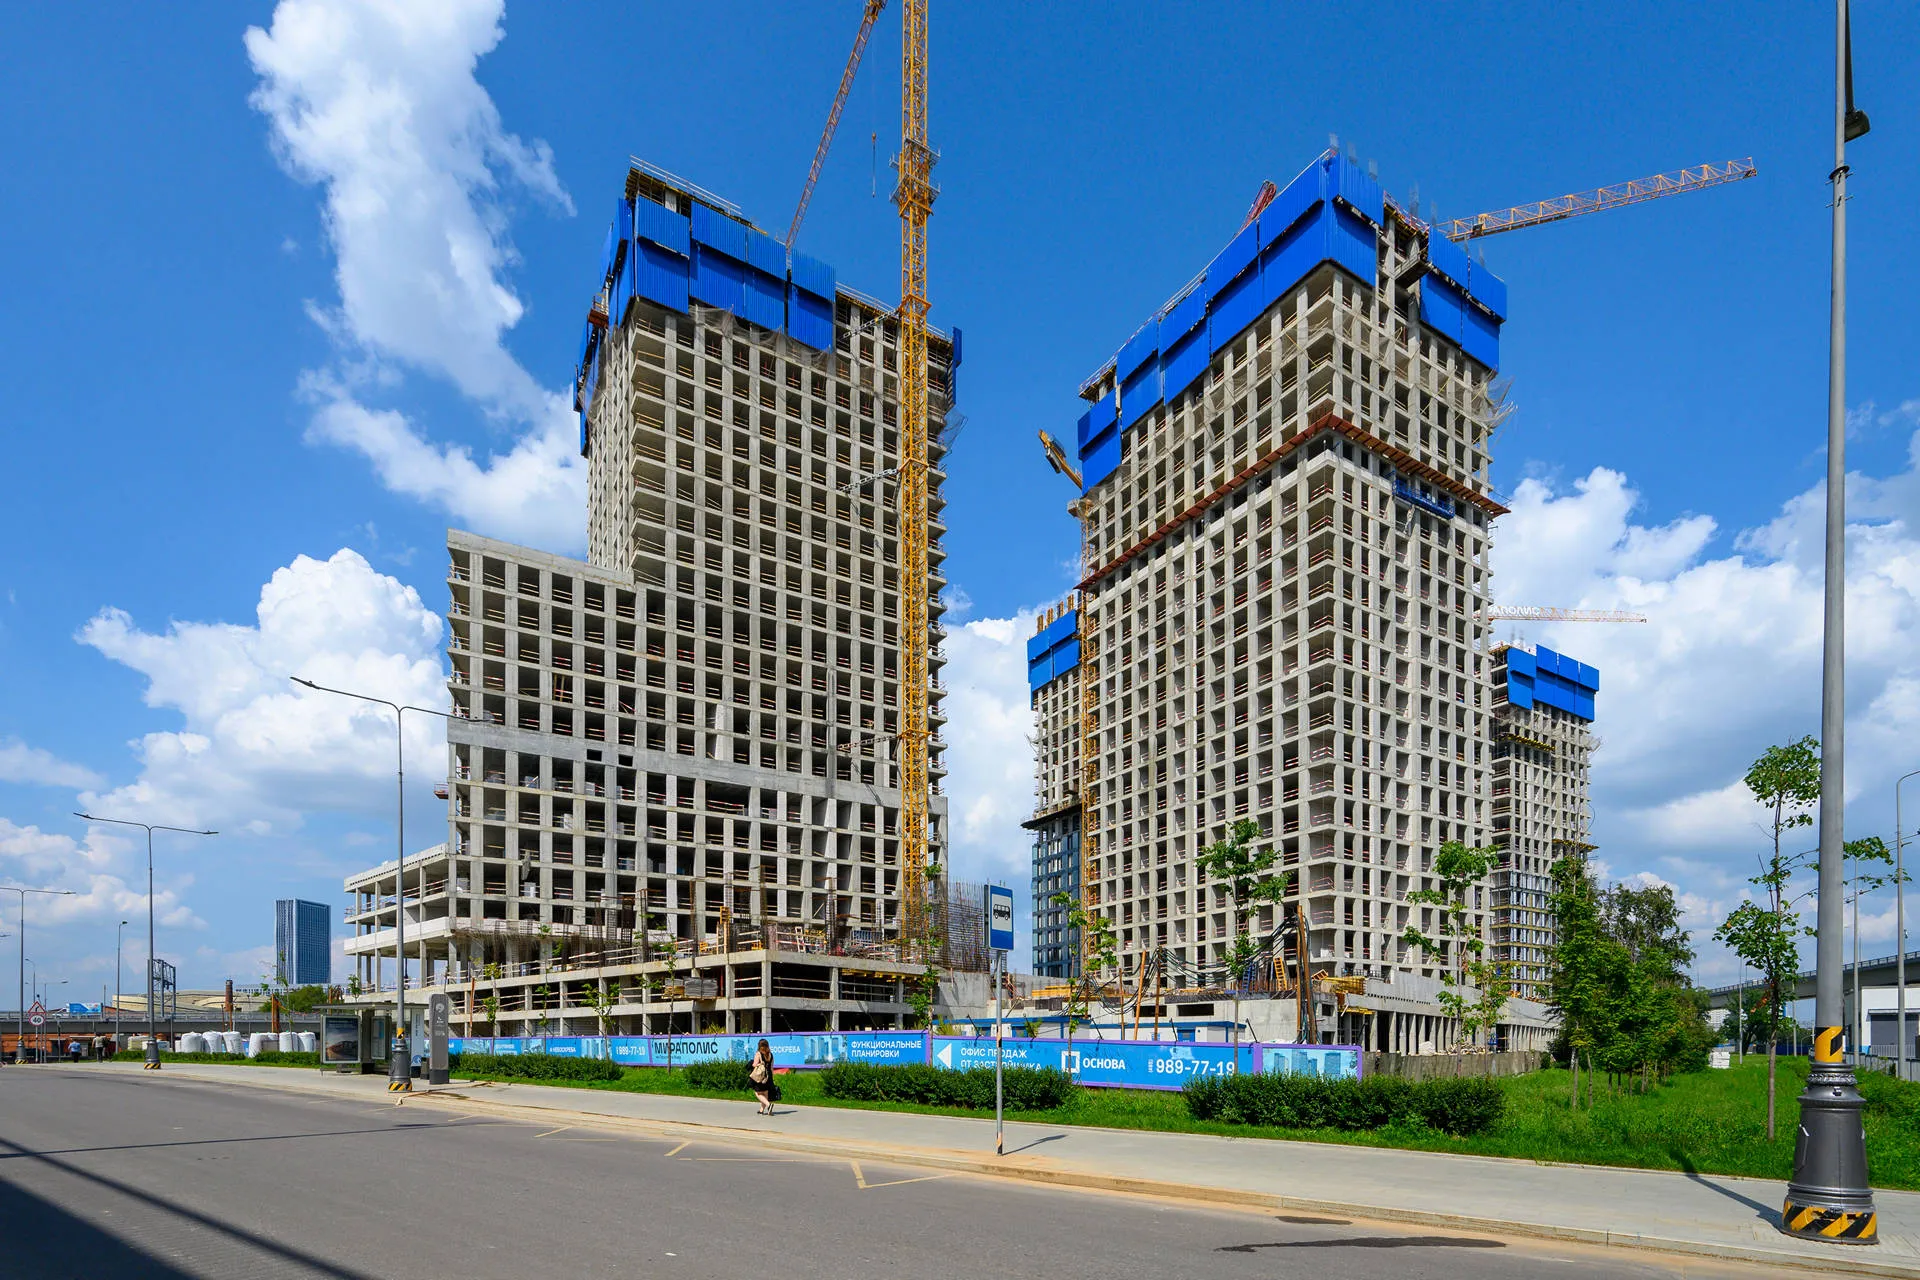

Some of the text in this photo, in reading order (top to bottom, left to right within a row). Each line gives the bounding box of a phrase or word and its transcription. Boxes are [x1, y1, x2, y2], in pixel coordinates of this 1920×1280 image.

[654, 1042, 718, 1054] МИРАПОЛИС
[851, 1040, 922, 1049] ФУНКЦИОНАЛЬНЫЕ
[851, 1049, 899, 1058] ПЛАНИРОВКИ
[960, 1047, 986, 1057] ОФИС
[1082, 1057, 1126, 1070] ОСНОВА
[1156, 1058, 1235, 1077] 989-77-19
